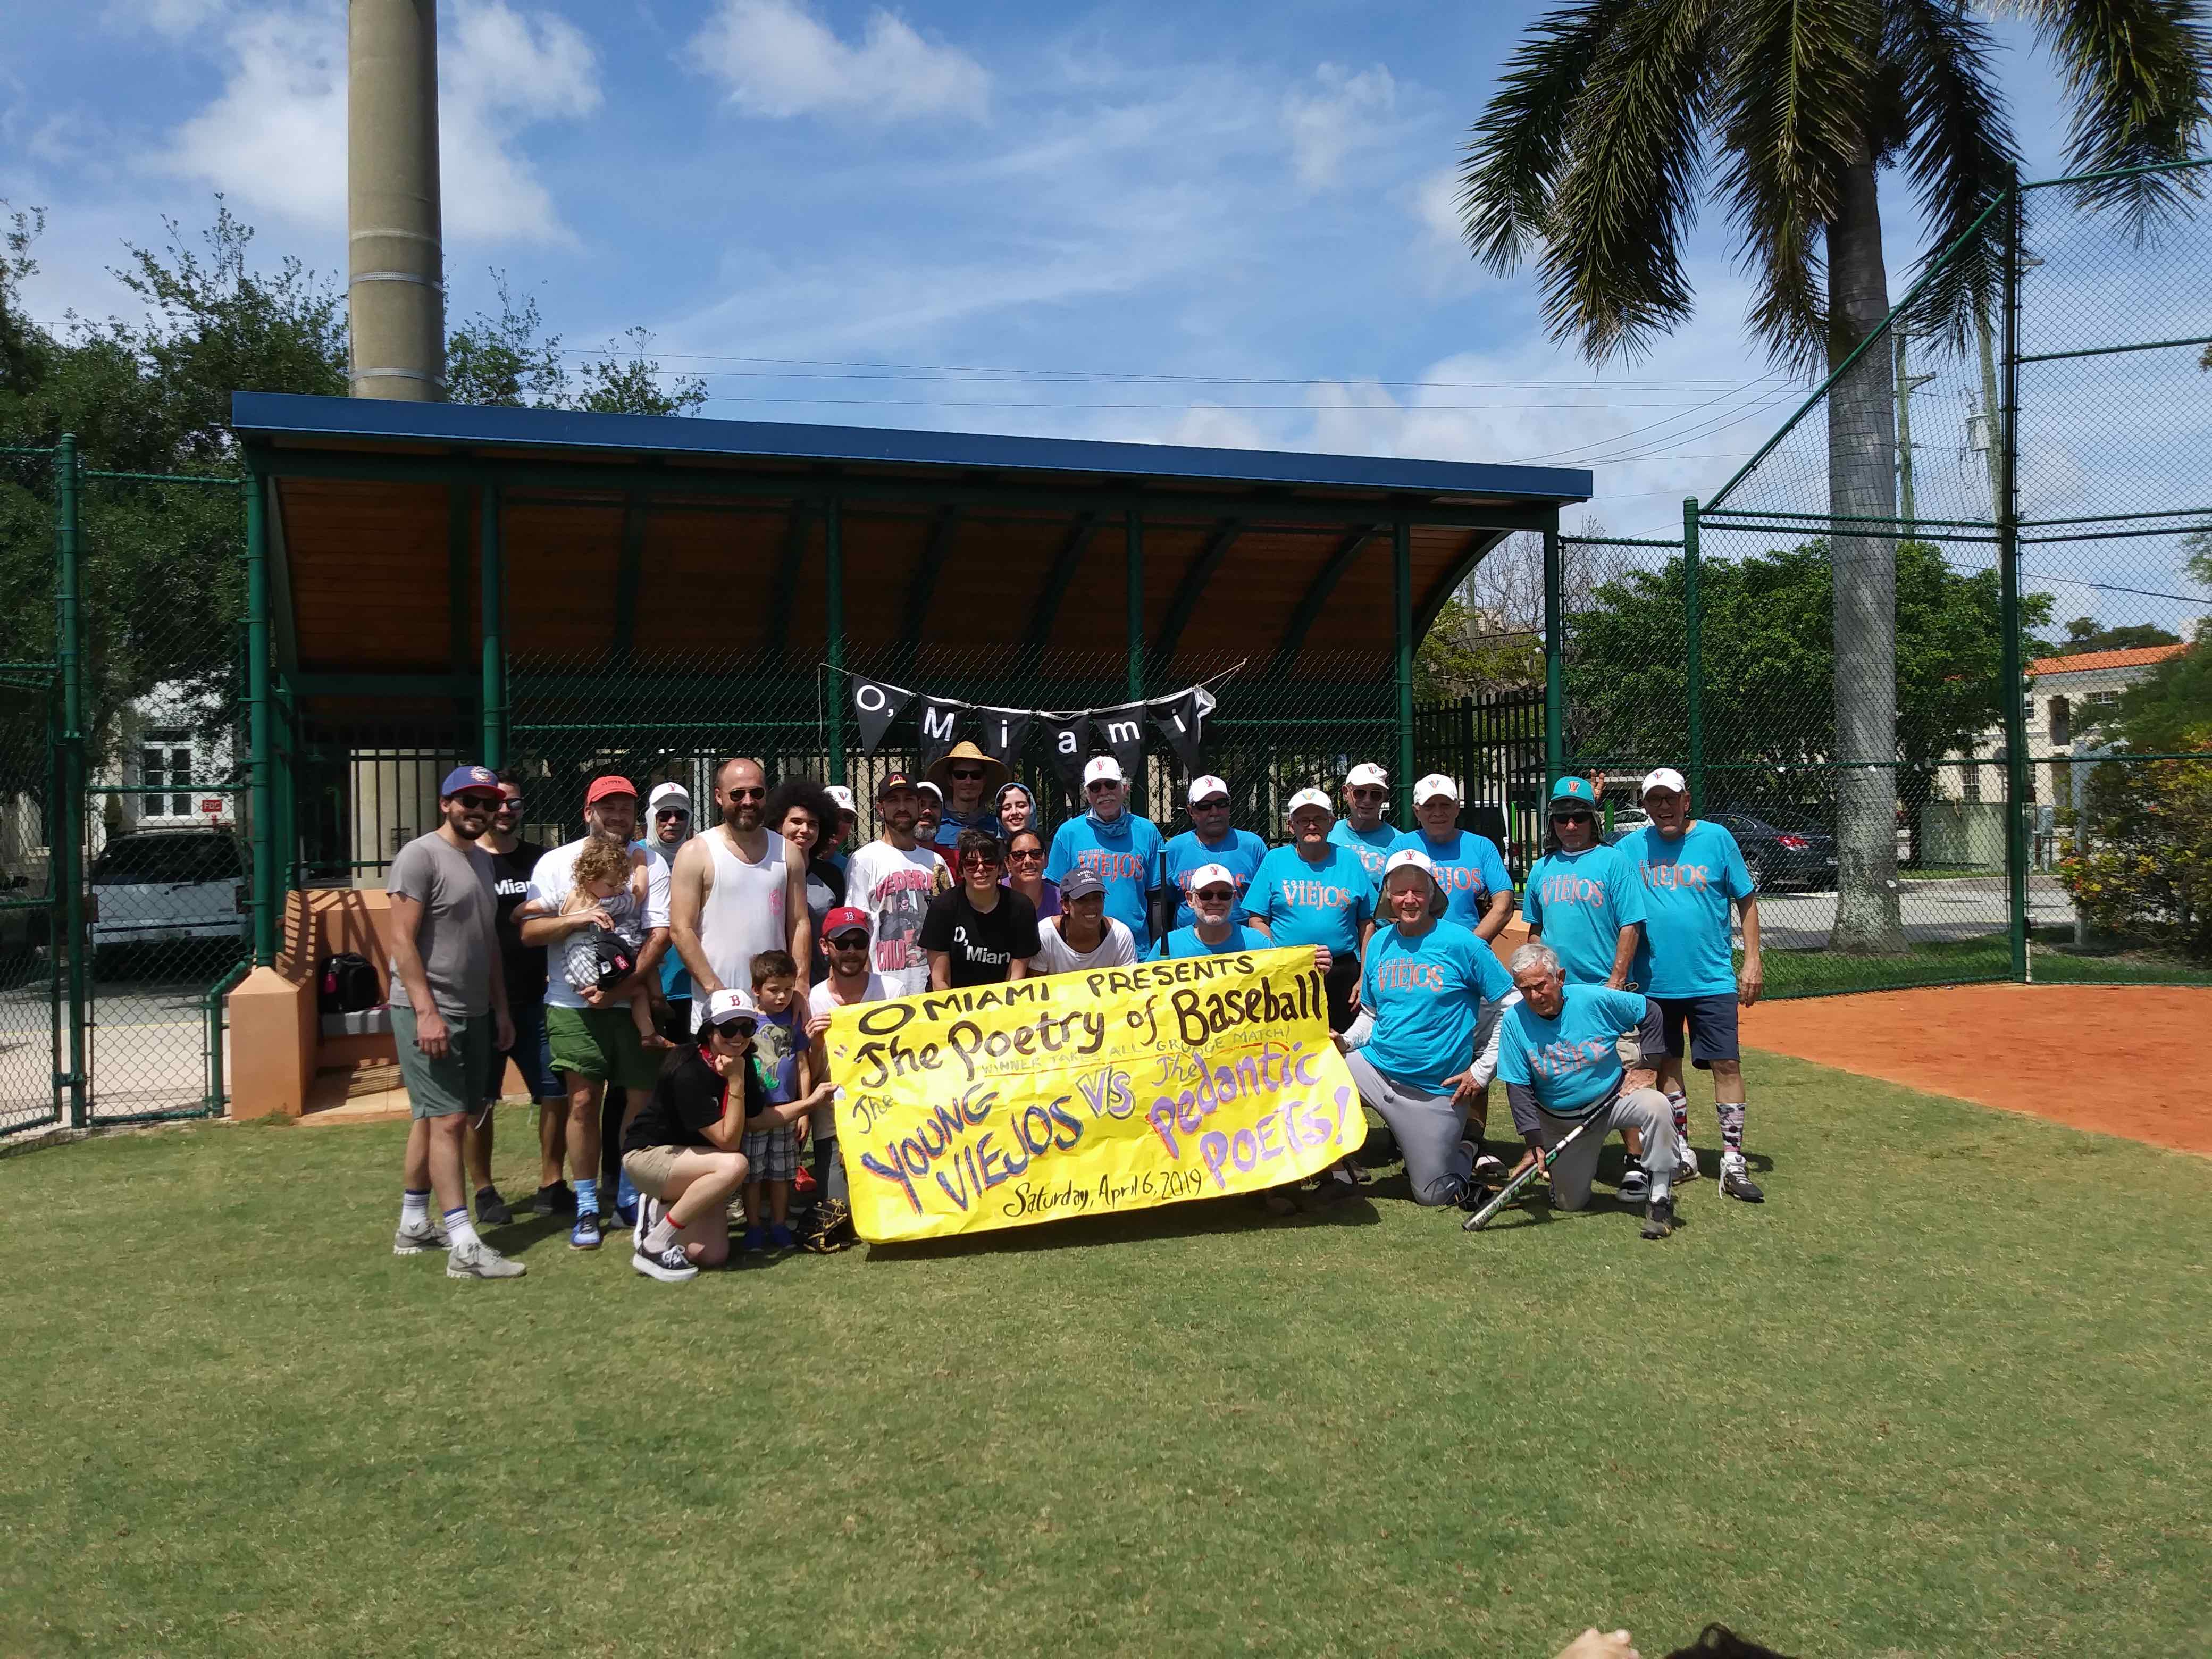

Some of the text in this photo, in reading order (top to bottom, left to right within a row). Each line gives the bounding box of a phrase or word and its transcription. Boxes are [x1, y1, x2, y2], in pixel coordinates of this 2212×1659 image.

[923, 706, 1189, 754] Miami
[494, 878, 532, 895] Mia
[1282, 885, 1351, 911] VIEJOS
[1432, 867, 1483, 894] EJOS
[1541, 878, 1605, 908] VIEJOS
[1639, 864, 1708, 892] VIEJOS
[729, 995, 741, 1006] B
[858, 954, 1255, 1036] O MIAMI PRESENTS
[1378, 963, 1445, 993] VIEJOS
[853, 969, 1323, 1088] The Poetry of Baseball
[981, 1057, 1042, 1075] WINNER
[1109, 1043, 1143, 1057] ALL
[1155, 1036, 1226, 1058] GRUDGE
[1233, 1026, 1291, 1043] MATCH!
[1075, 1065, 1136, 1120] VS
[1152, 1053, 1197, 1087] The
[852, 1082, 1000, 1217] The YOUNG
[935, 1094, 1085, 1212] VIEJOS
[1199, 1085, 1351, 1190] POETS!
[1003, 1179, 1094, 1217] Saturday,
[1098, 1174, 1138, 1209] April
[1160, 1168, 1202, 1201] 2019
